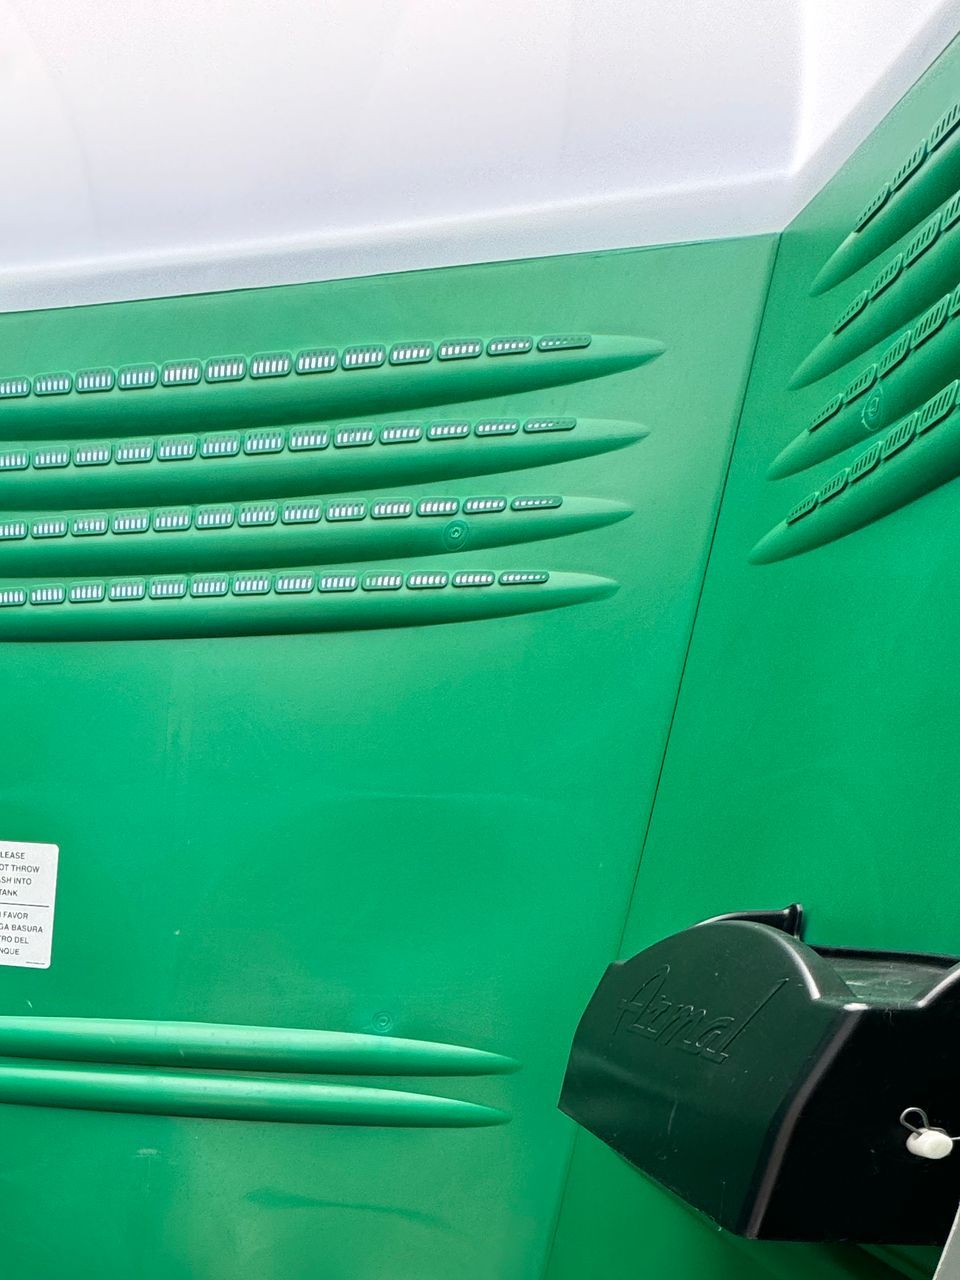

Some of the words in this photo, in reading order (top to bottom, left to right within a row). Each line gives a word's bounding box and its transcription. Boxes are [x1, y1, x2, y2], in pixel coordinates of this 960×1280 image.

[11, 865, 40, 873] THROW
[13, 877, 32, 885] INTO
[3, 911, 29, 920] FAVOR
[11, 924, 43, 933] BASURA
[14, 936, 29, 944] DEL
